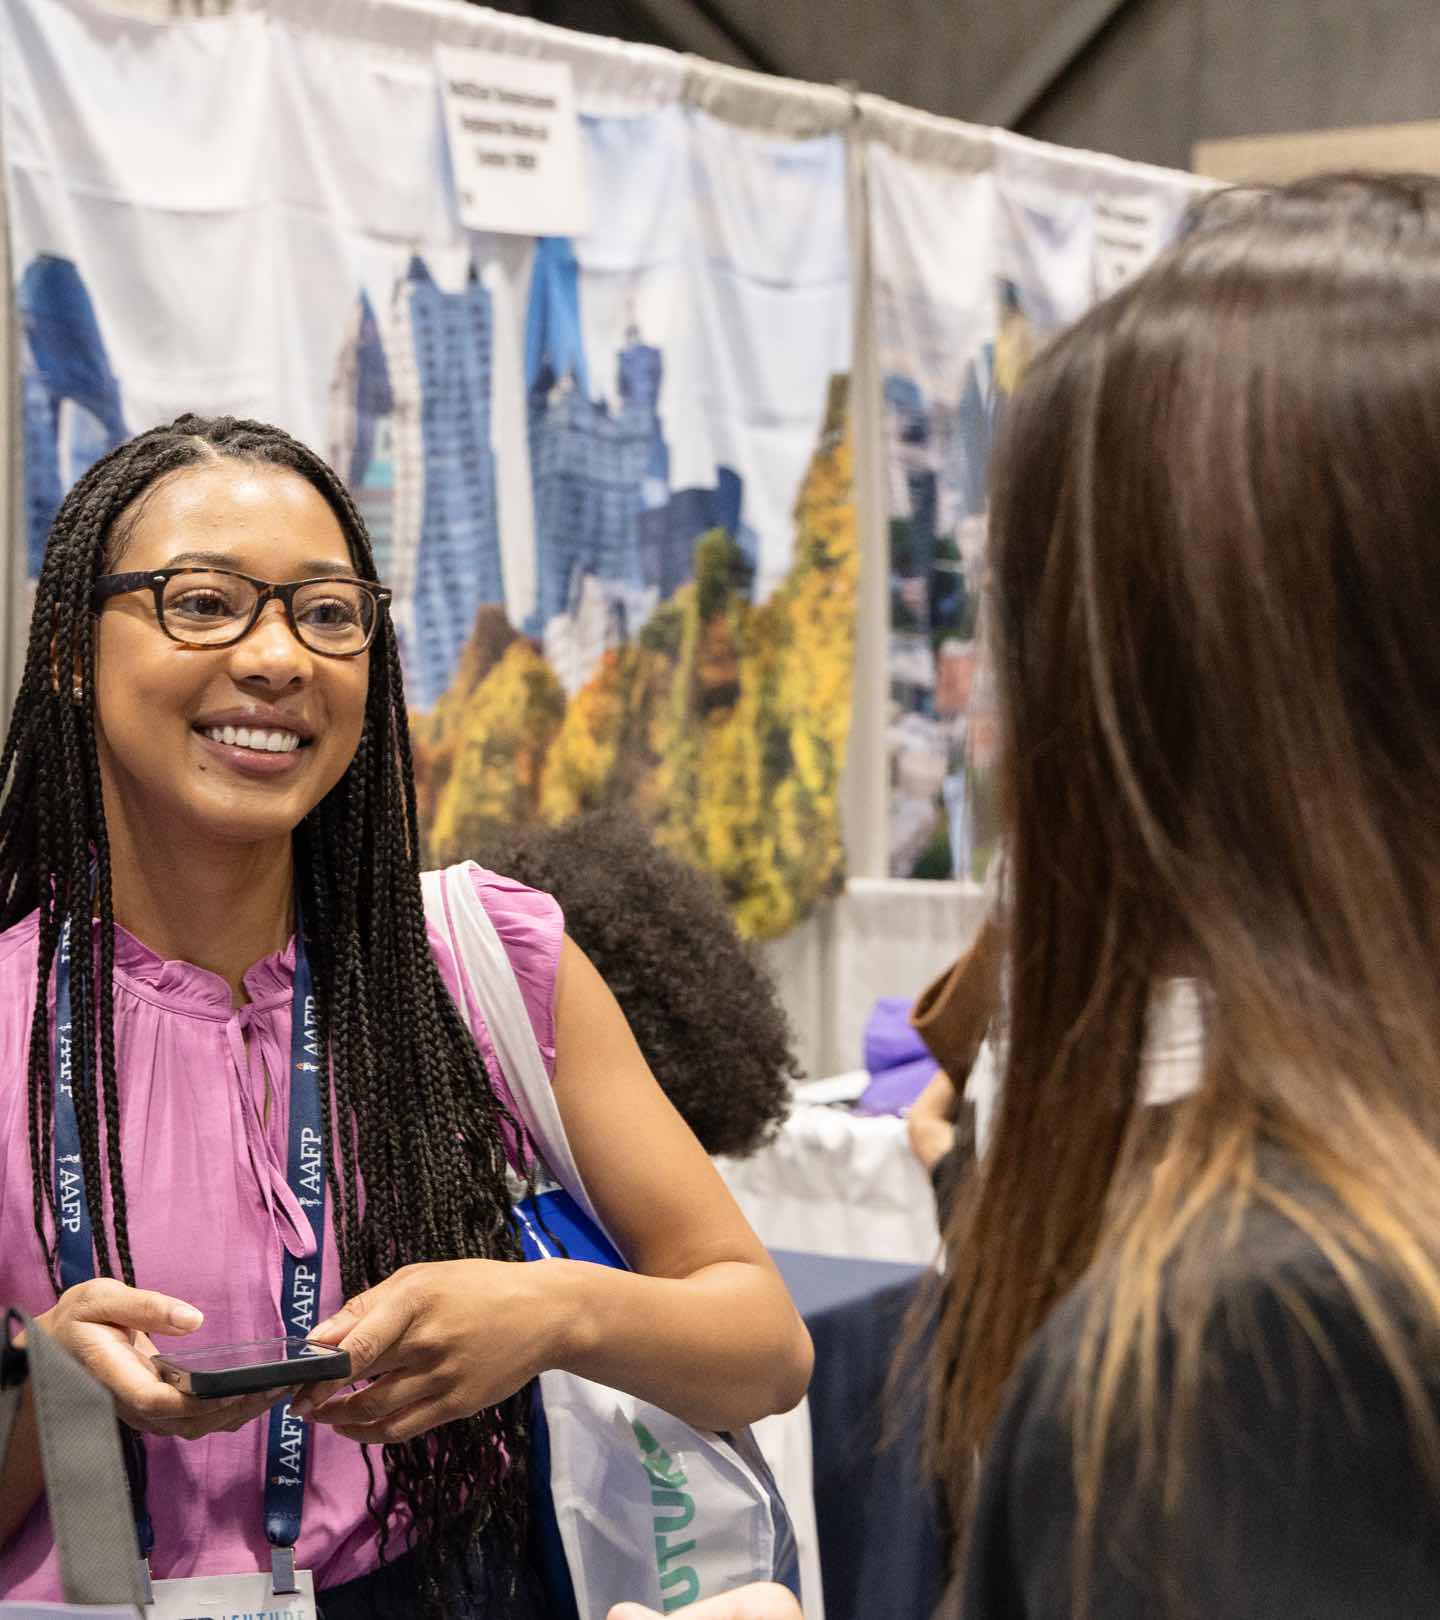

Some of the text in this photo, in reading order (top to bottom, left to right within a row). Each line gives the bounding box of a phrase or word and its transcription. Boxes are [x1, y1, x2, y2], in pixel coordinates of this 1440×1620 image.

[299, 1127, 322, 1195] AAFP
[60, 1167, 81, 1233] AAFP
[291, 1264, 316, 1332] AAFP
